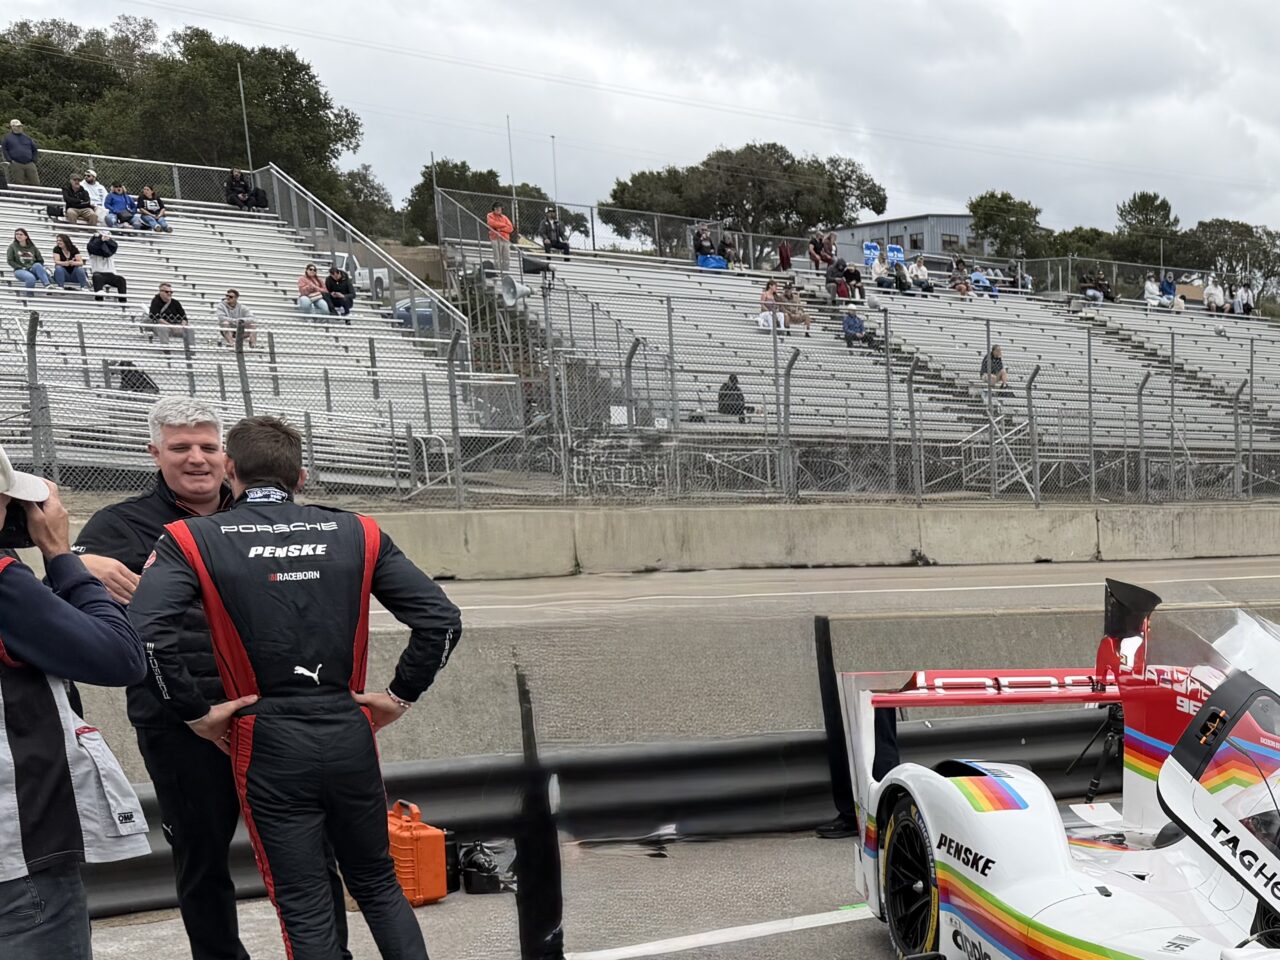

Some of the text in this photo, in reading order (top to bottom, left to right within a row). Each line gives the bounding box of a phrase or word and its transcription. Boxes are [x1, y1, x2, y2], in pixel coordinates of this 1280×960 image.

[220, 521, 338, 534] PORSCHE
[248, 544, 327, 558] PENSKE
[277, 570, 320, 581] RACEBORN
[117, 812, 135, 823] OMP
[936, 832, 997, 878] PENSKE
